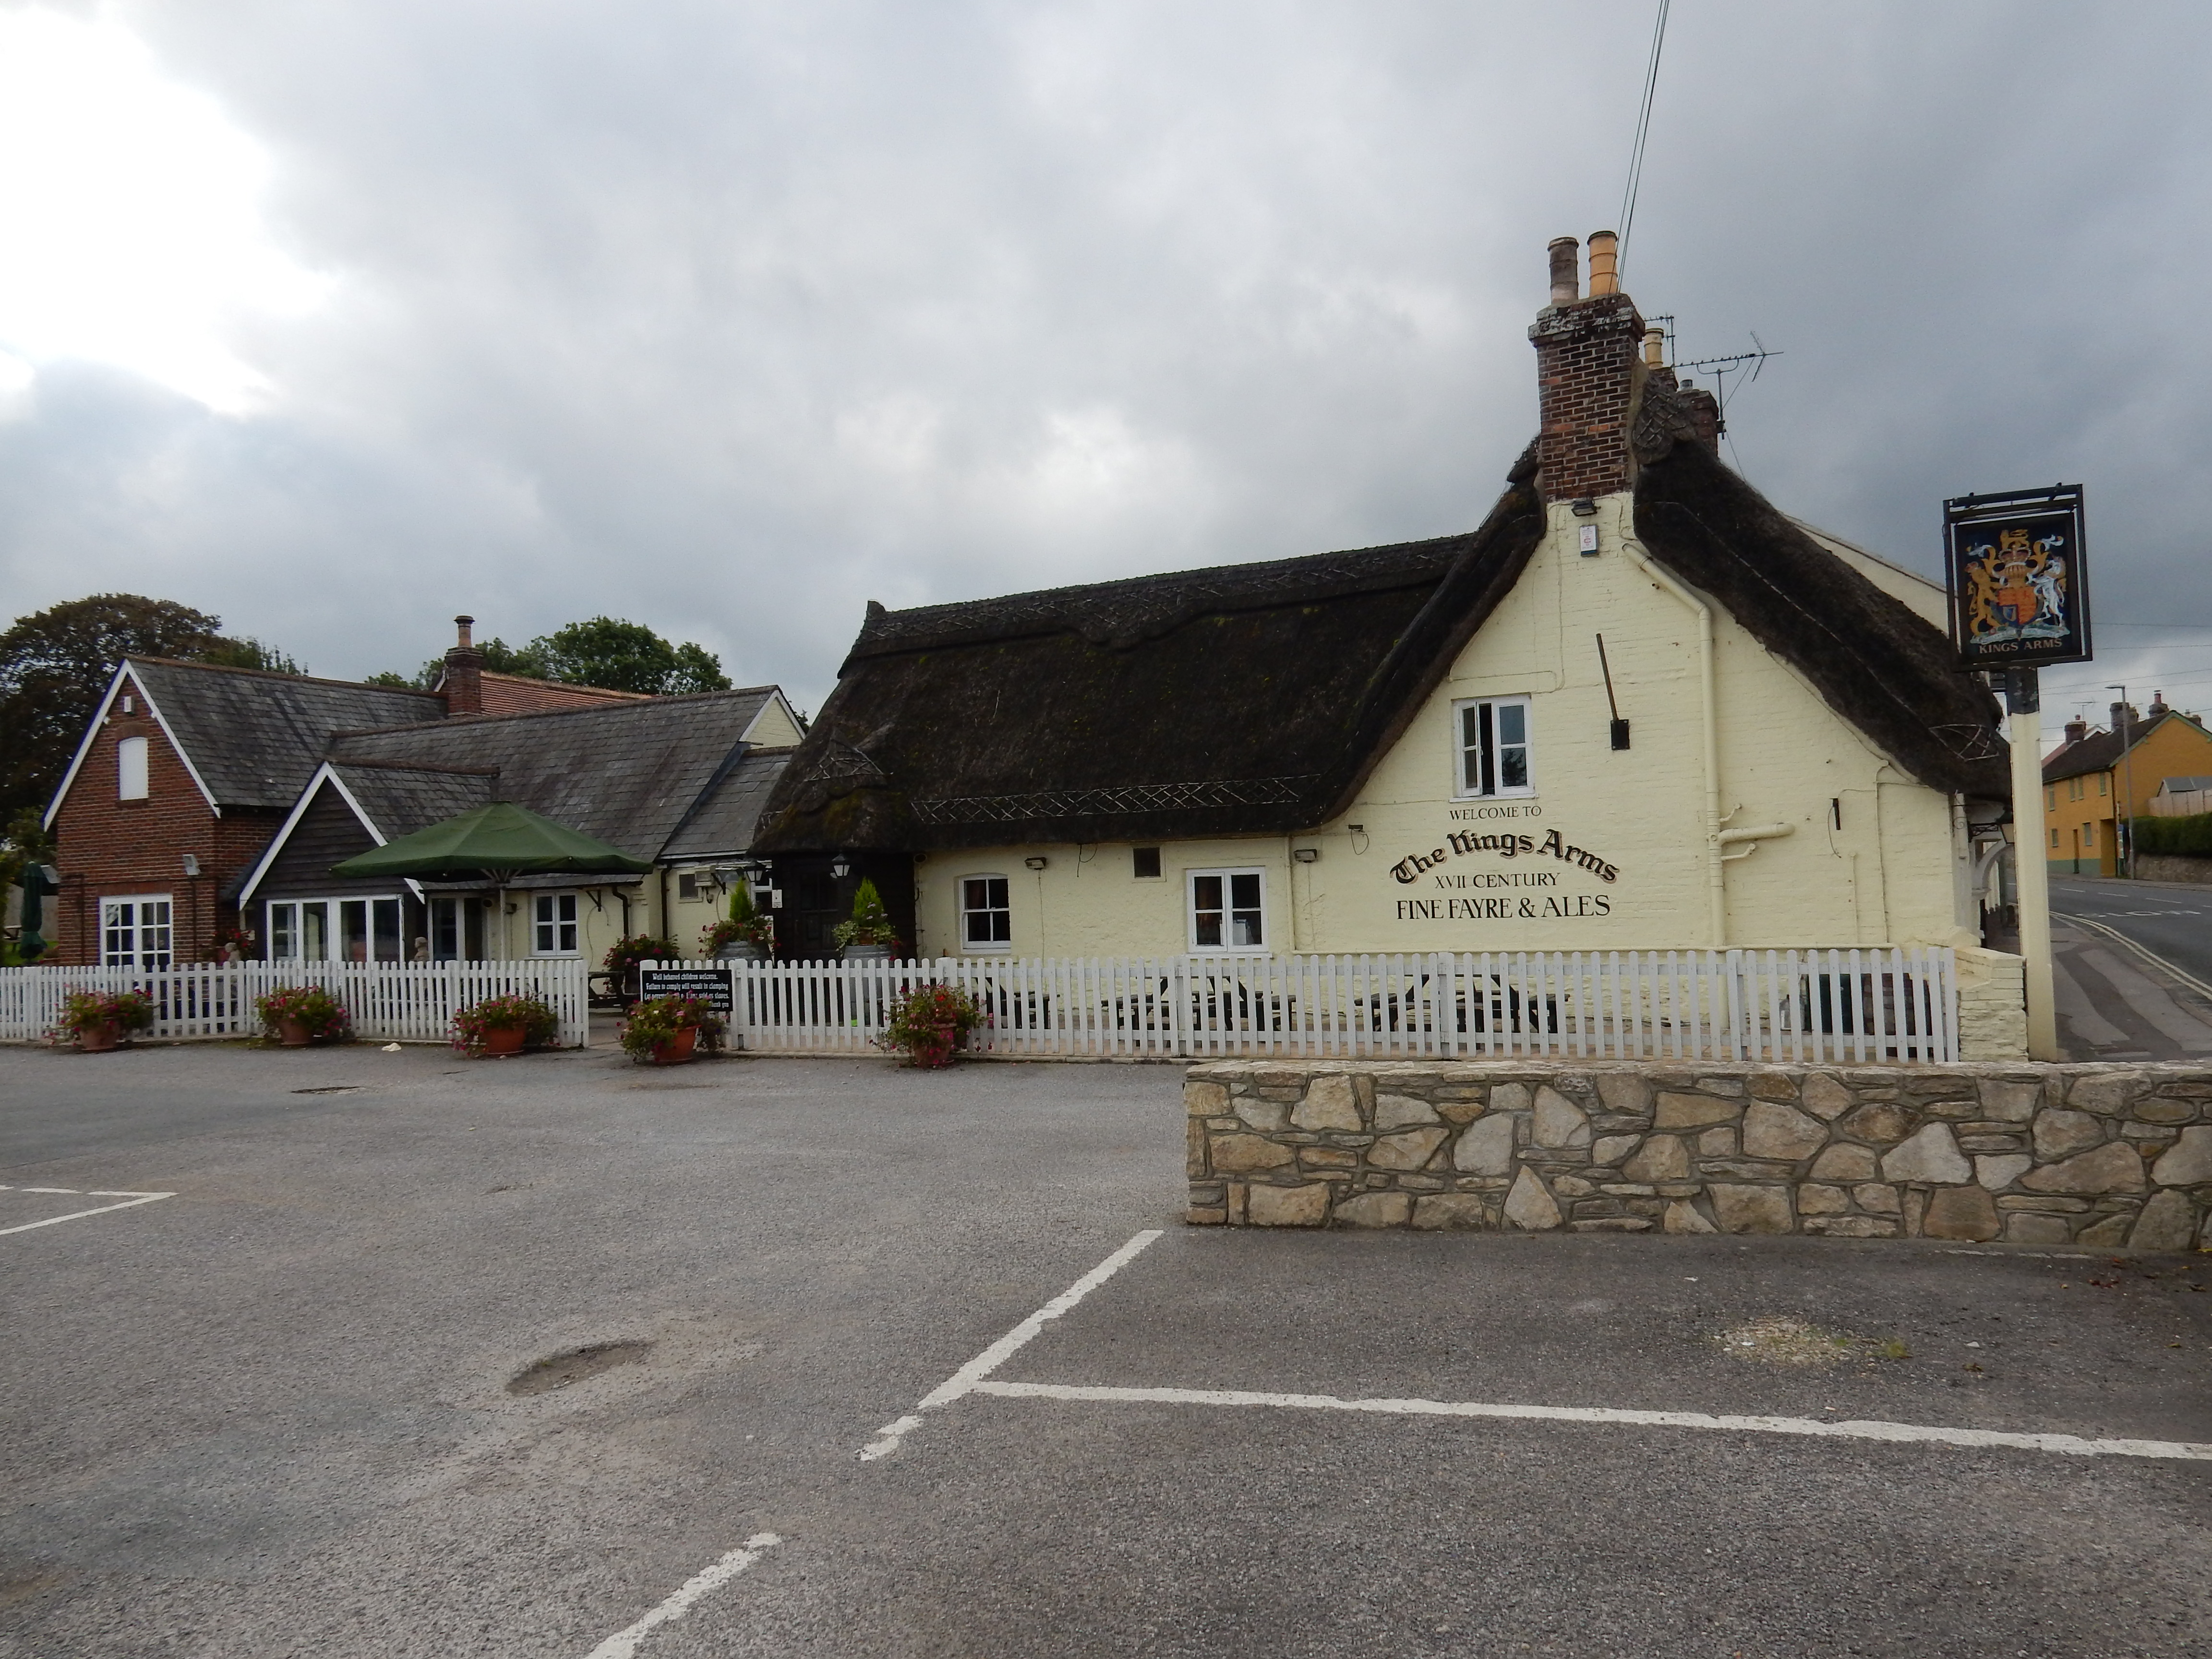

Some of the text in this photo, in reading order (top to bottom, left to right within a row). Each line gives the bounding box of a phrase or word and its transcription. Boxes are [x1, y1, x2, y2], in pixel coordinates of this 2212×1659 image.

[1979, 638, 2063, 654] KINGS ARMS
[1449, 805, 1541, 820] WELCOME TO
[1390, 829, 1620, 884] The Kings Arms
[1435, 872, 1561, 889] XVII CENTURY
[1396, 894, 1611, 919] FINE FAYRE & ALES
[666, 983, 681, 991] comply
[709, 982, 729, 991] clamping
